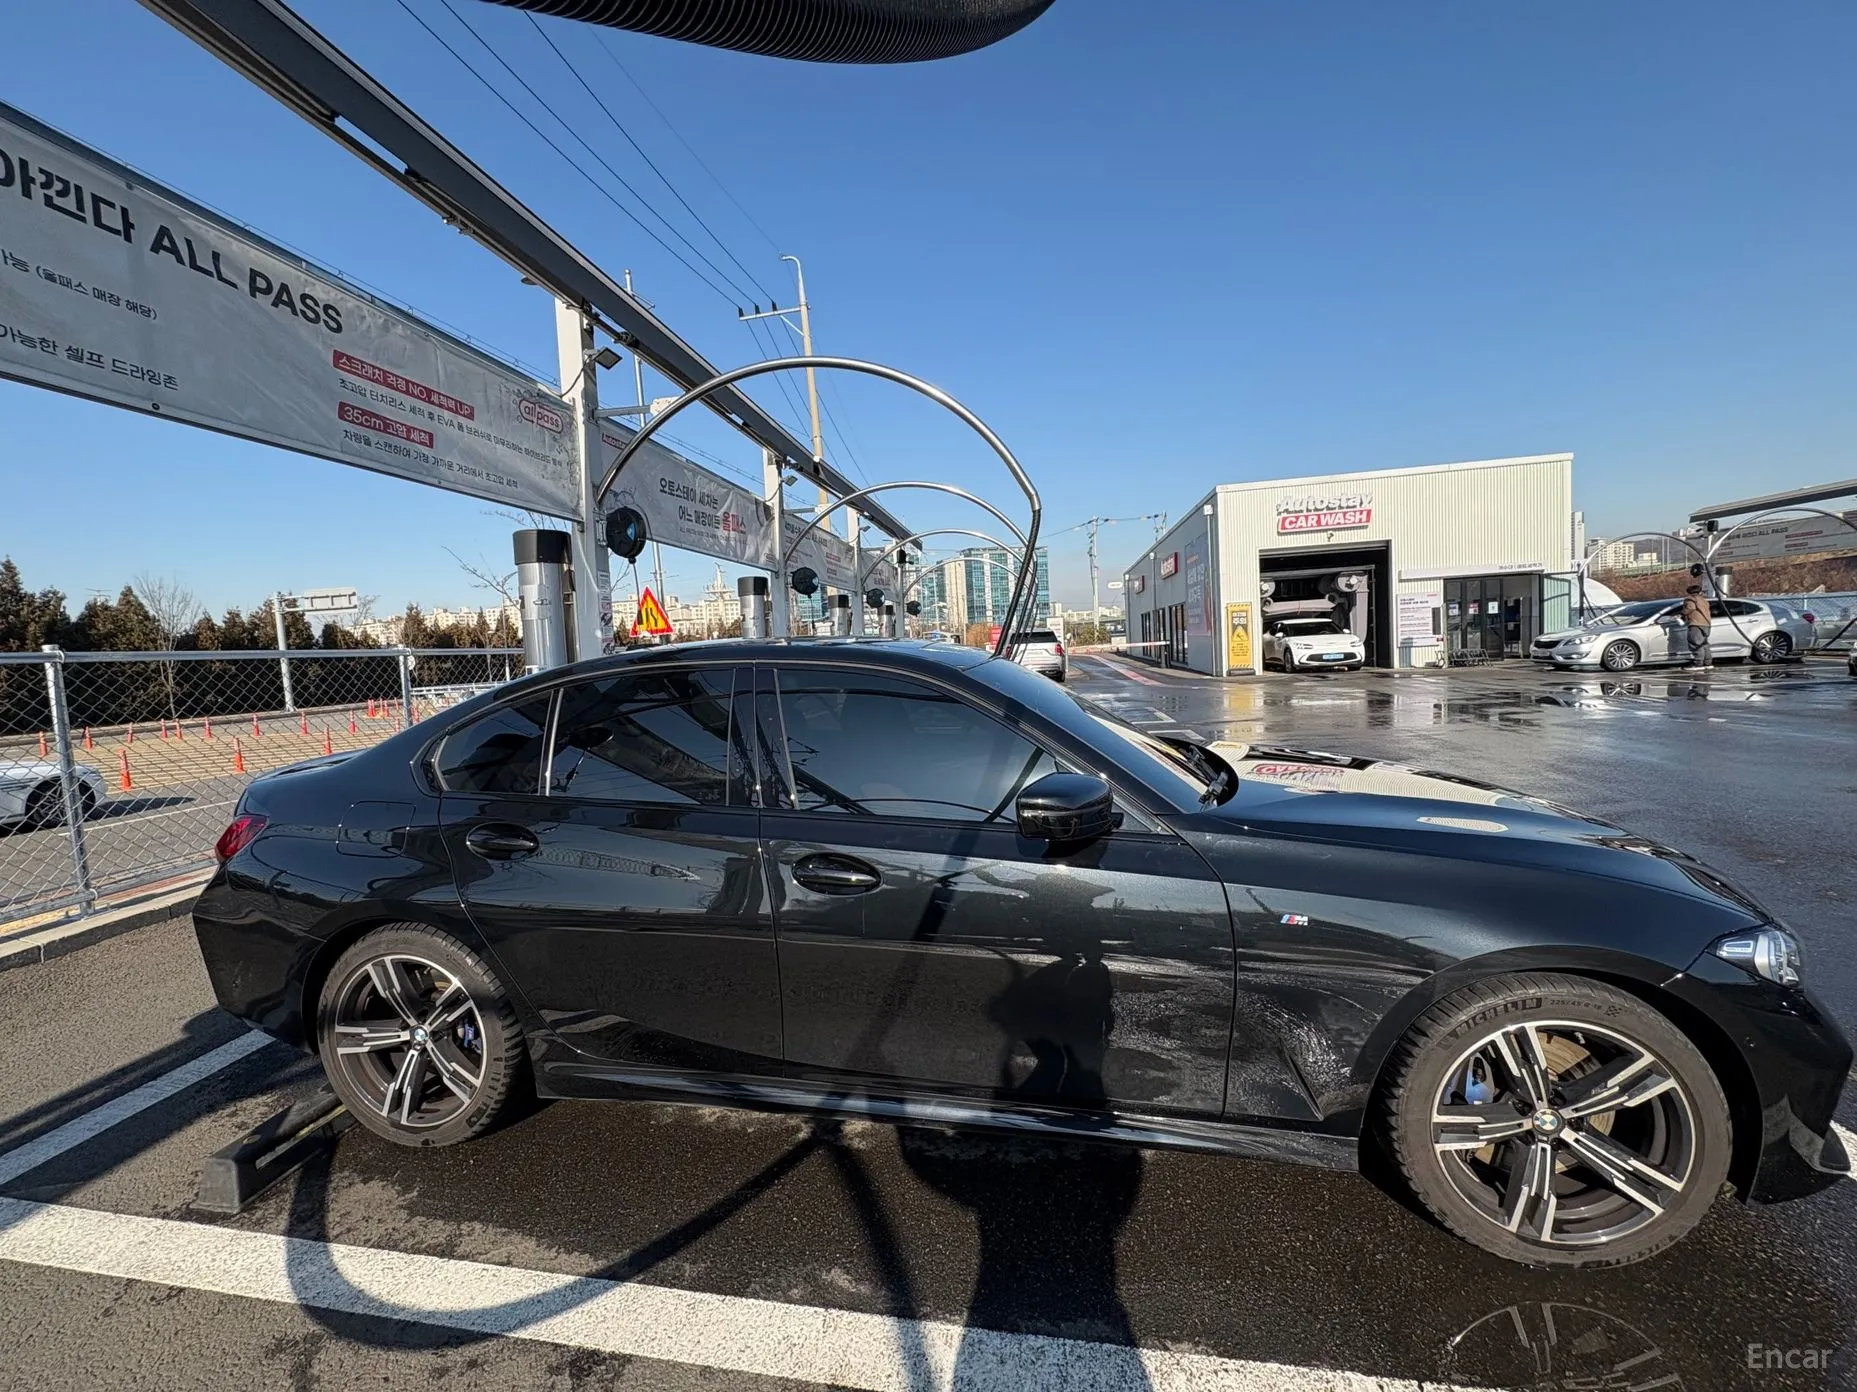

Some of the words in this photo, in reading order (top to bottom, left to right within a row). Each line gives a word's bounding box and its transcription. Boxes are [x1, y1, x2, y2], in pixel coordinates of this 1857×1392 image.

[36, 265, 89, 296] (올패스
[92, 287, 121, 307] 매장
[125, 299, 157, 320] 해당)
[150, 224, 239, 290] ALL
[249, 267, 343, 334] PASS
[64, 345, 105, 369] 셀프
[111, 358, 179, 391] 드라잉존
[339, 356, 384, 383] 스크래치
[387, 375, 406, 391] 걱정
[409, 385, 429, 400] NO,
[431, 391, 456, 411] 세척력
[457, 403, 471, 415] UP
[338, 378, 367, 397] 초고압
[370, 389, 407, 411] 터치리스
[409, 404, 426, 418] 세척
[427, 410, 436, 421] 후
[437, 414, 455, 429] EVA
[343, 406, 384, 430] 35cm
[387, 419, 408, 437] 고압
[410, 425, 431, 447] 세척
[343, 429, 371, 447] 차량을
[375, 439, 411, 459] 스캔하여
[413, 450, 430, 464] 가장
[456, 462, 484, 480] 거리에서
[485, 472, 504, 486] 초고압
[659, 477, 697, 505] 오토스테이
[699, 491, 719, 510] 세차는
[1277, 493, 1373, 516] Autostay
[678, 505, 693, 522] 어느
[694, 510, 721, 530] 매장이든
[722, 511, 746, 535] 올패스
[1284, 515, 1318, 529] CAR
[1320, 510, 1367, 527] WASH
[1455, 998, 1541, 1038] MICHELIN
